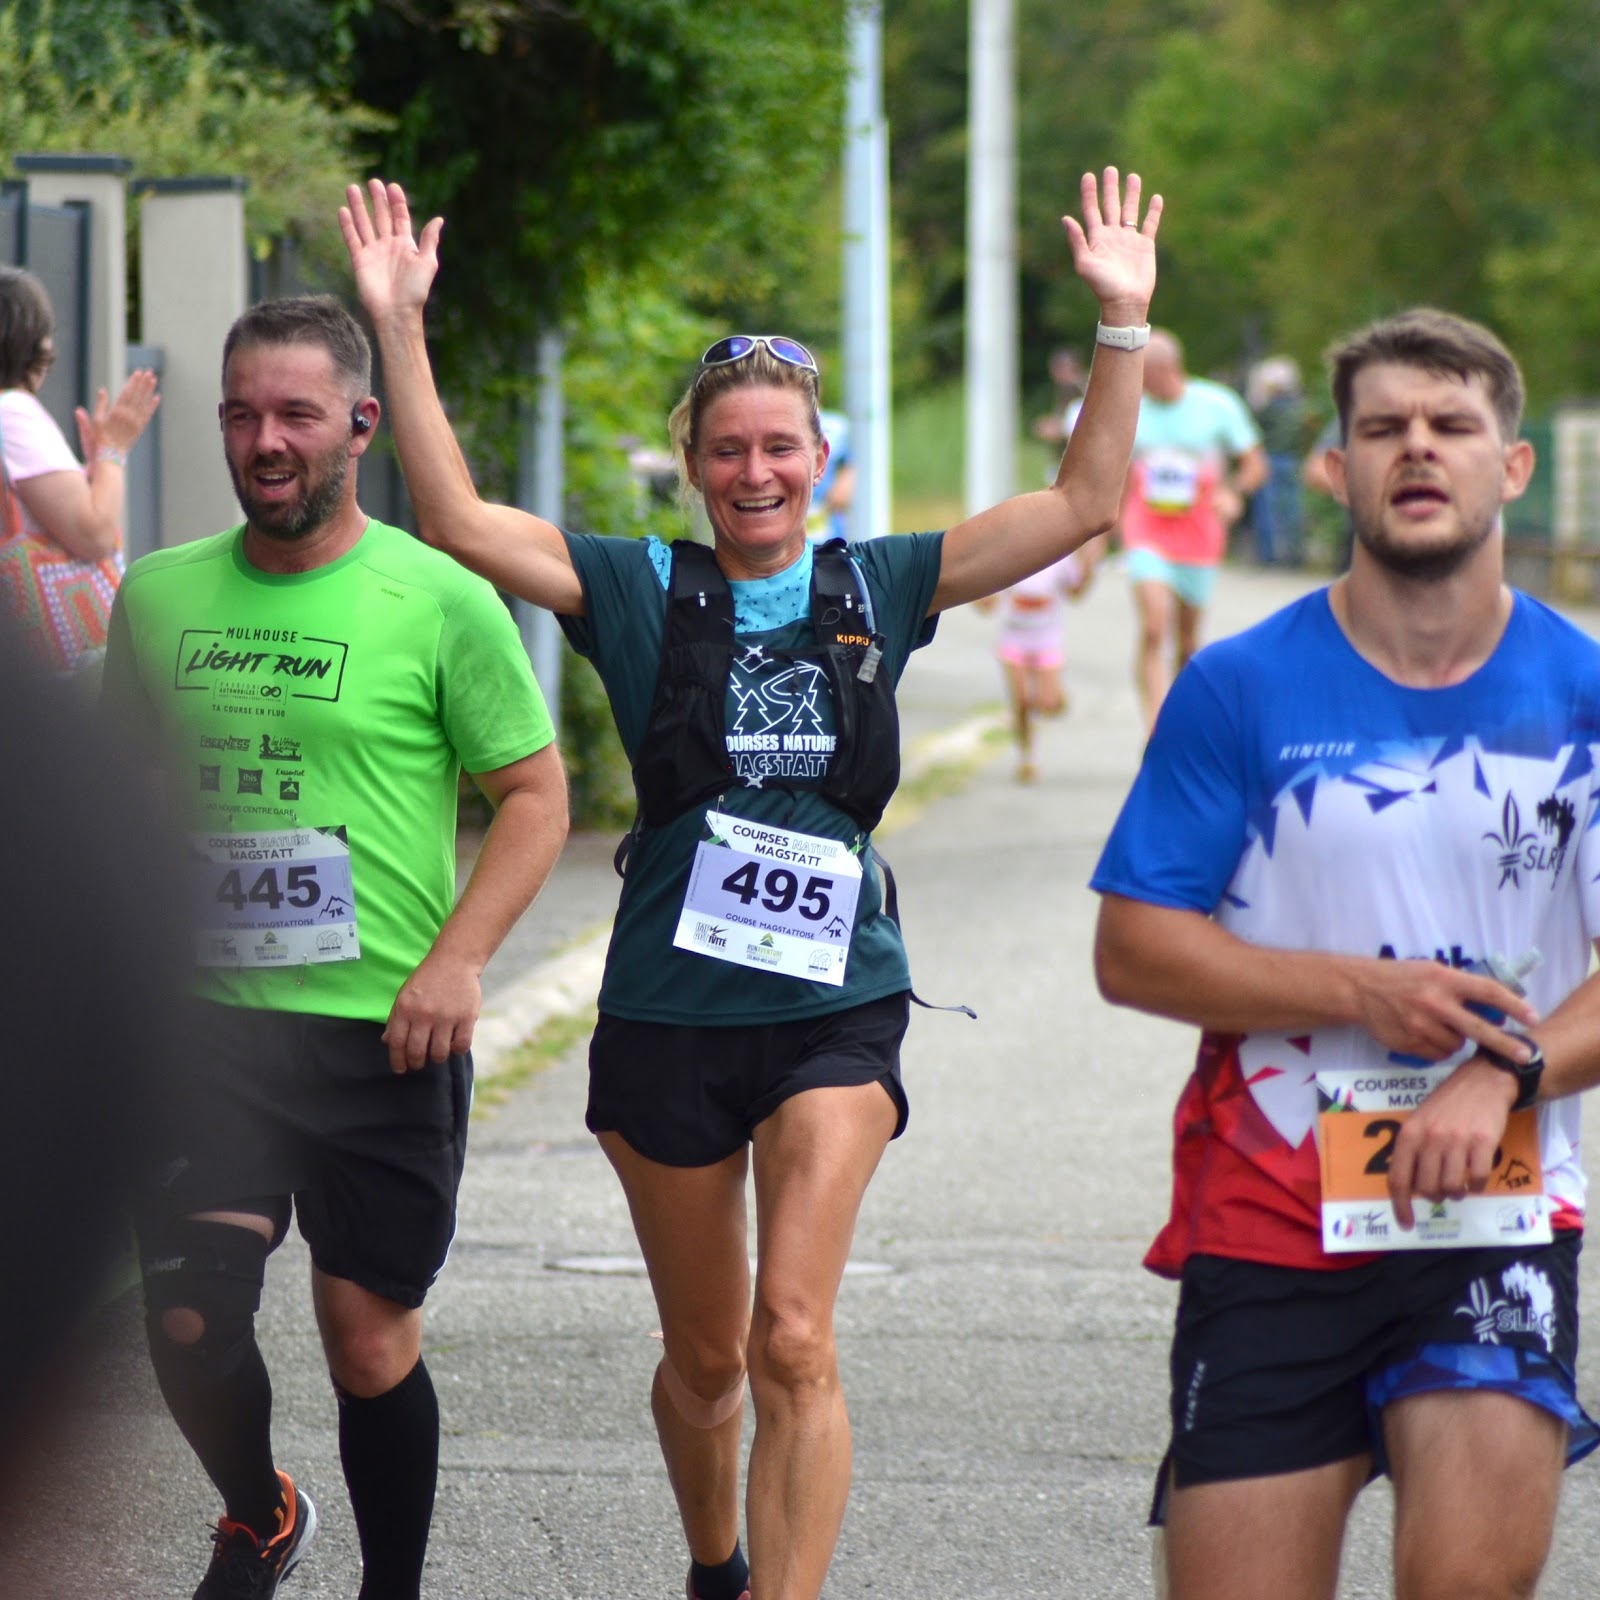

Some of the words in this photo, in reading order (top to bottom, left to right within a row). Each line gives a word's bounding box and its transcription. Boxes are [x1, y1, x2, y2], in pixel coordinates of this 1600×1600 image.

[226, 627, 298, 643] MULHOUSE
[836, 634, 870, 646] KIPRU
[272, 654, 332, 680] RUN
[212, 704, 221, 712] TA
[223, 705, 252, 715] COURSE
[267, 709, 285, 717] FLUO
[726, 734, 779, 752] OURSES
[1279, 741, 1356, 761] KINETIK
[729, 753, 833, 777] AGSTATT
[243, 773, 257, 782] ibis
[242, 806, 273, 815] CENTRE
[273, 808, 294, 816] GARE
[208, 838, 257, 848] COURSES
[260, 834, 310, 846] NATURE
[732, 824, 790, 847] COURSES
[792, 839, 838, 858] NATURE
[230, 848, 294, 860] MAGSTATT
[754, 843, 821, 867] MAGSTATT
[216, 865, 321, 911] 445
[721, 861, 833, 921] 495
[329, 906, 345, 919] 7K
[258, 918, 315, 928] MAGSTATTOISE
[725, 913, 757, 927] COURSE
[759, 922, 815, 940] MAGSTATTOISE
[828, 929, 842, 938] 7K
[1354, 1077, 1428, 1092] COURSES
[1497, 1307, 1557, 1338] SLRC
